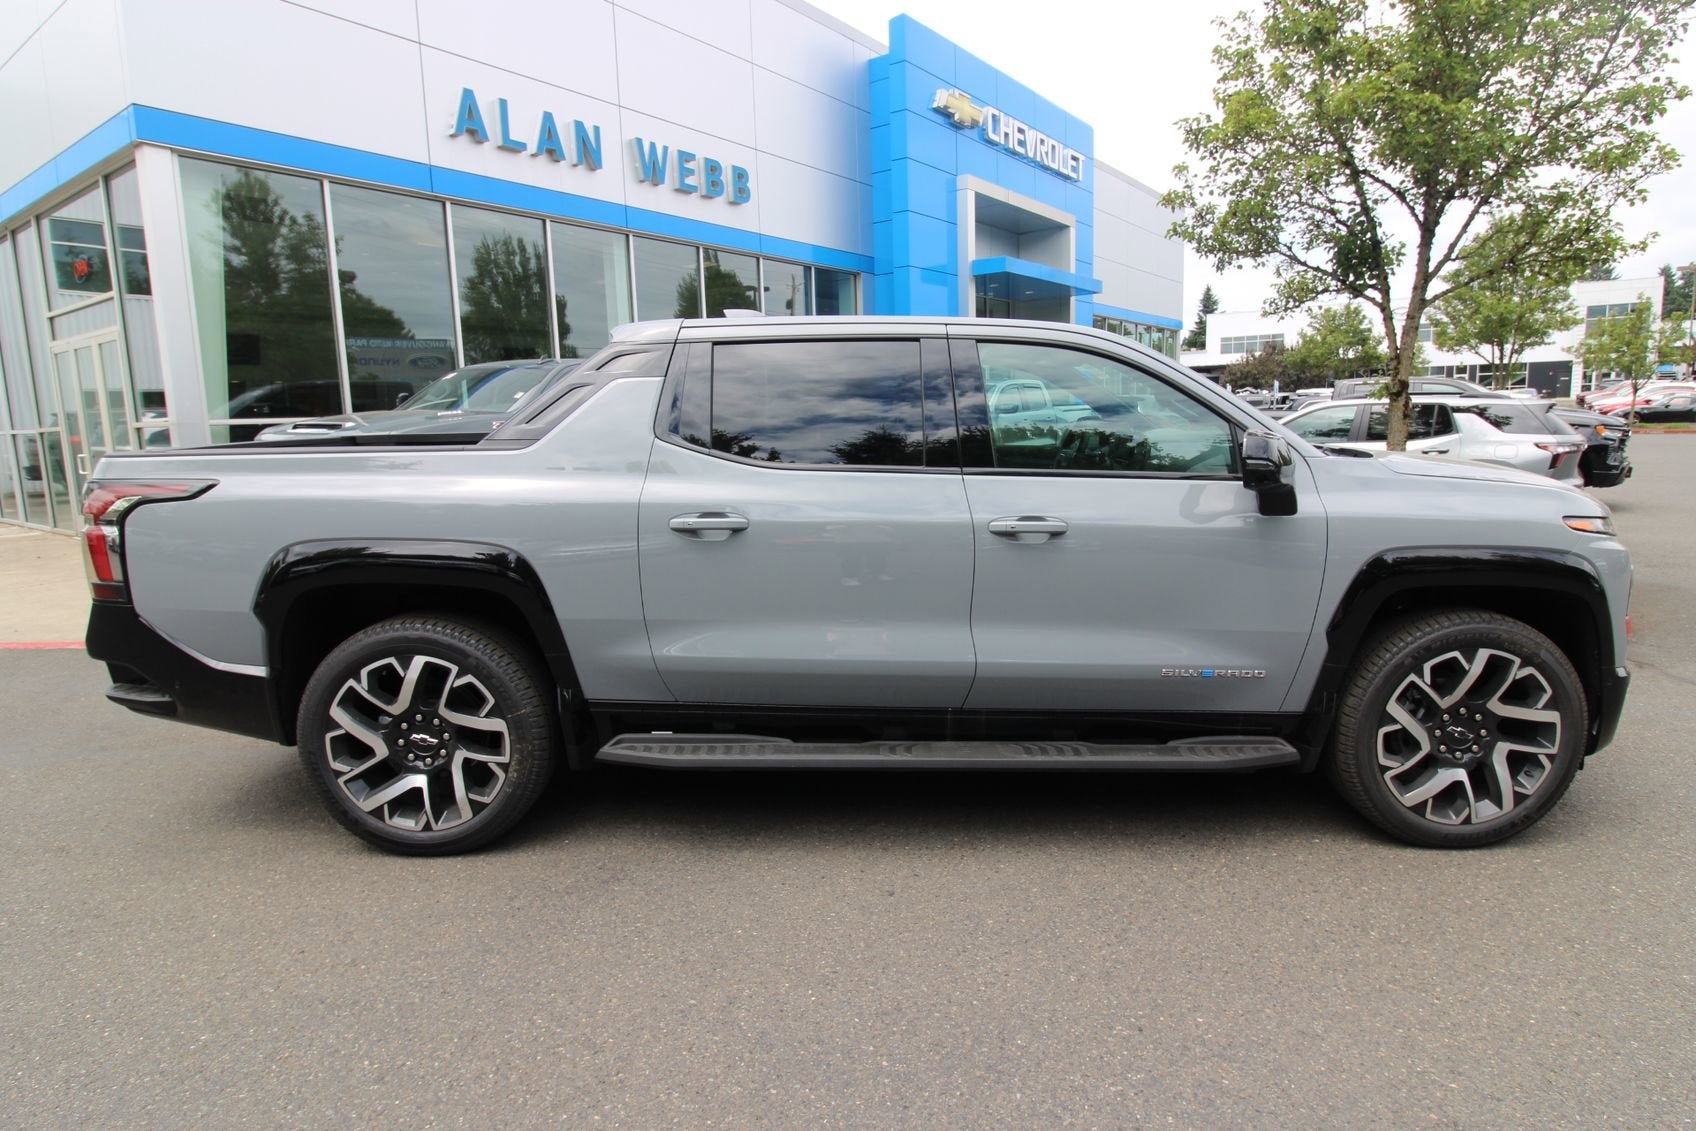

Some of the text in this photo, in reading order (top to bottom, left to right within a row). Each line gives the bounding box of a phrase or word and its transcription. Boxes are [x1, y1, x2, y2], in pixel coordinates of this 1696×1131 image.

[449, 87, 751, 205] ALAN WEBB
[984, 106, 1086, 182] CHEVROLET
[1160, 667, 1267, 679] SILVERADO
